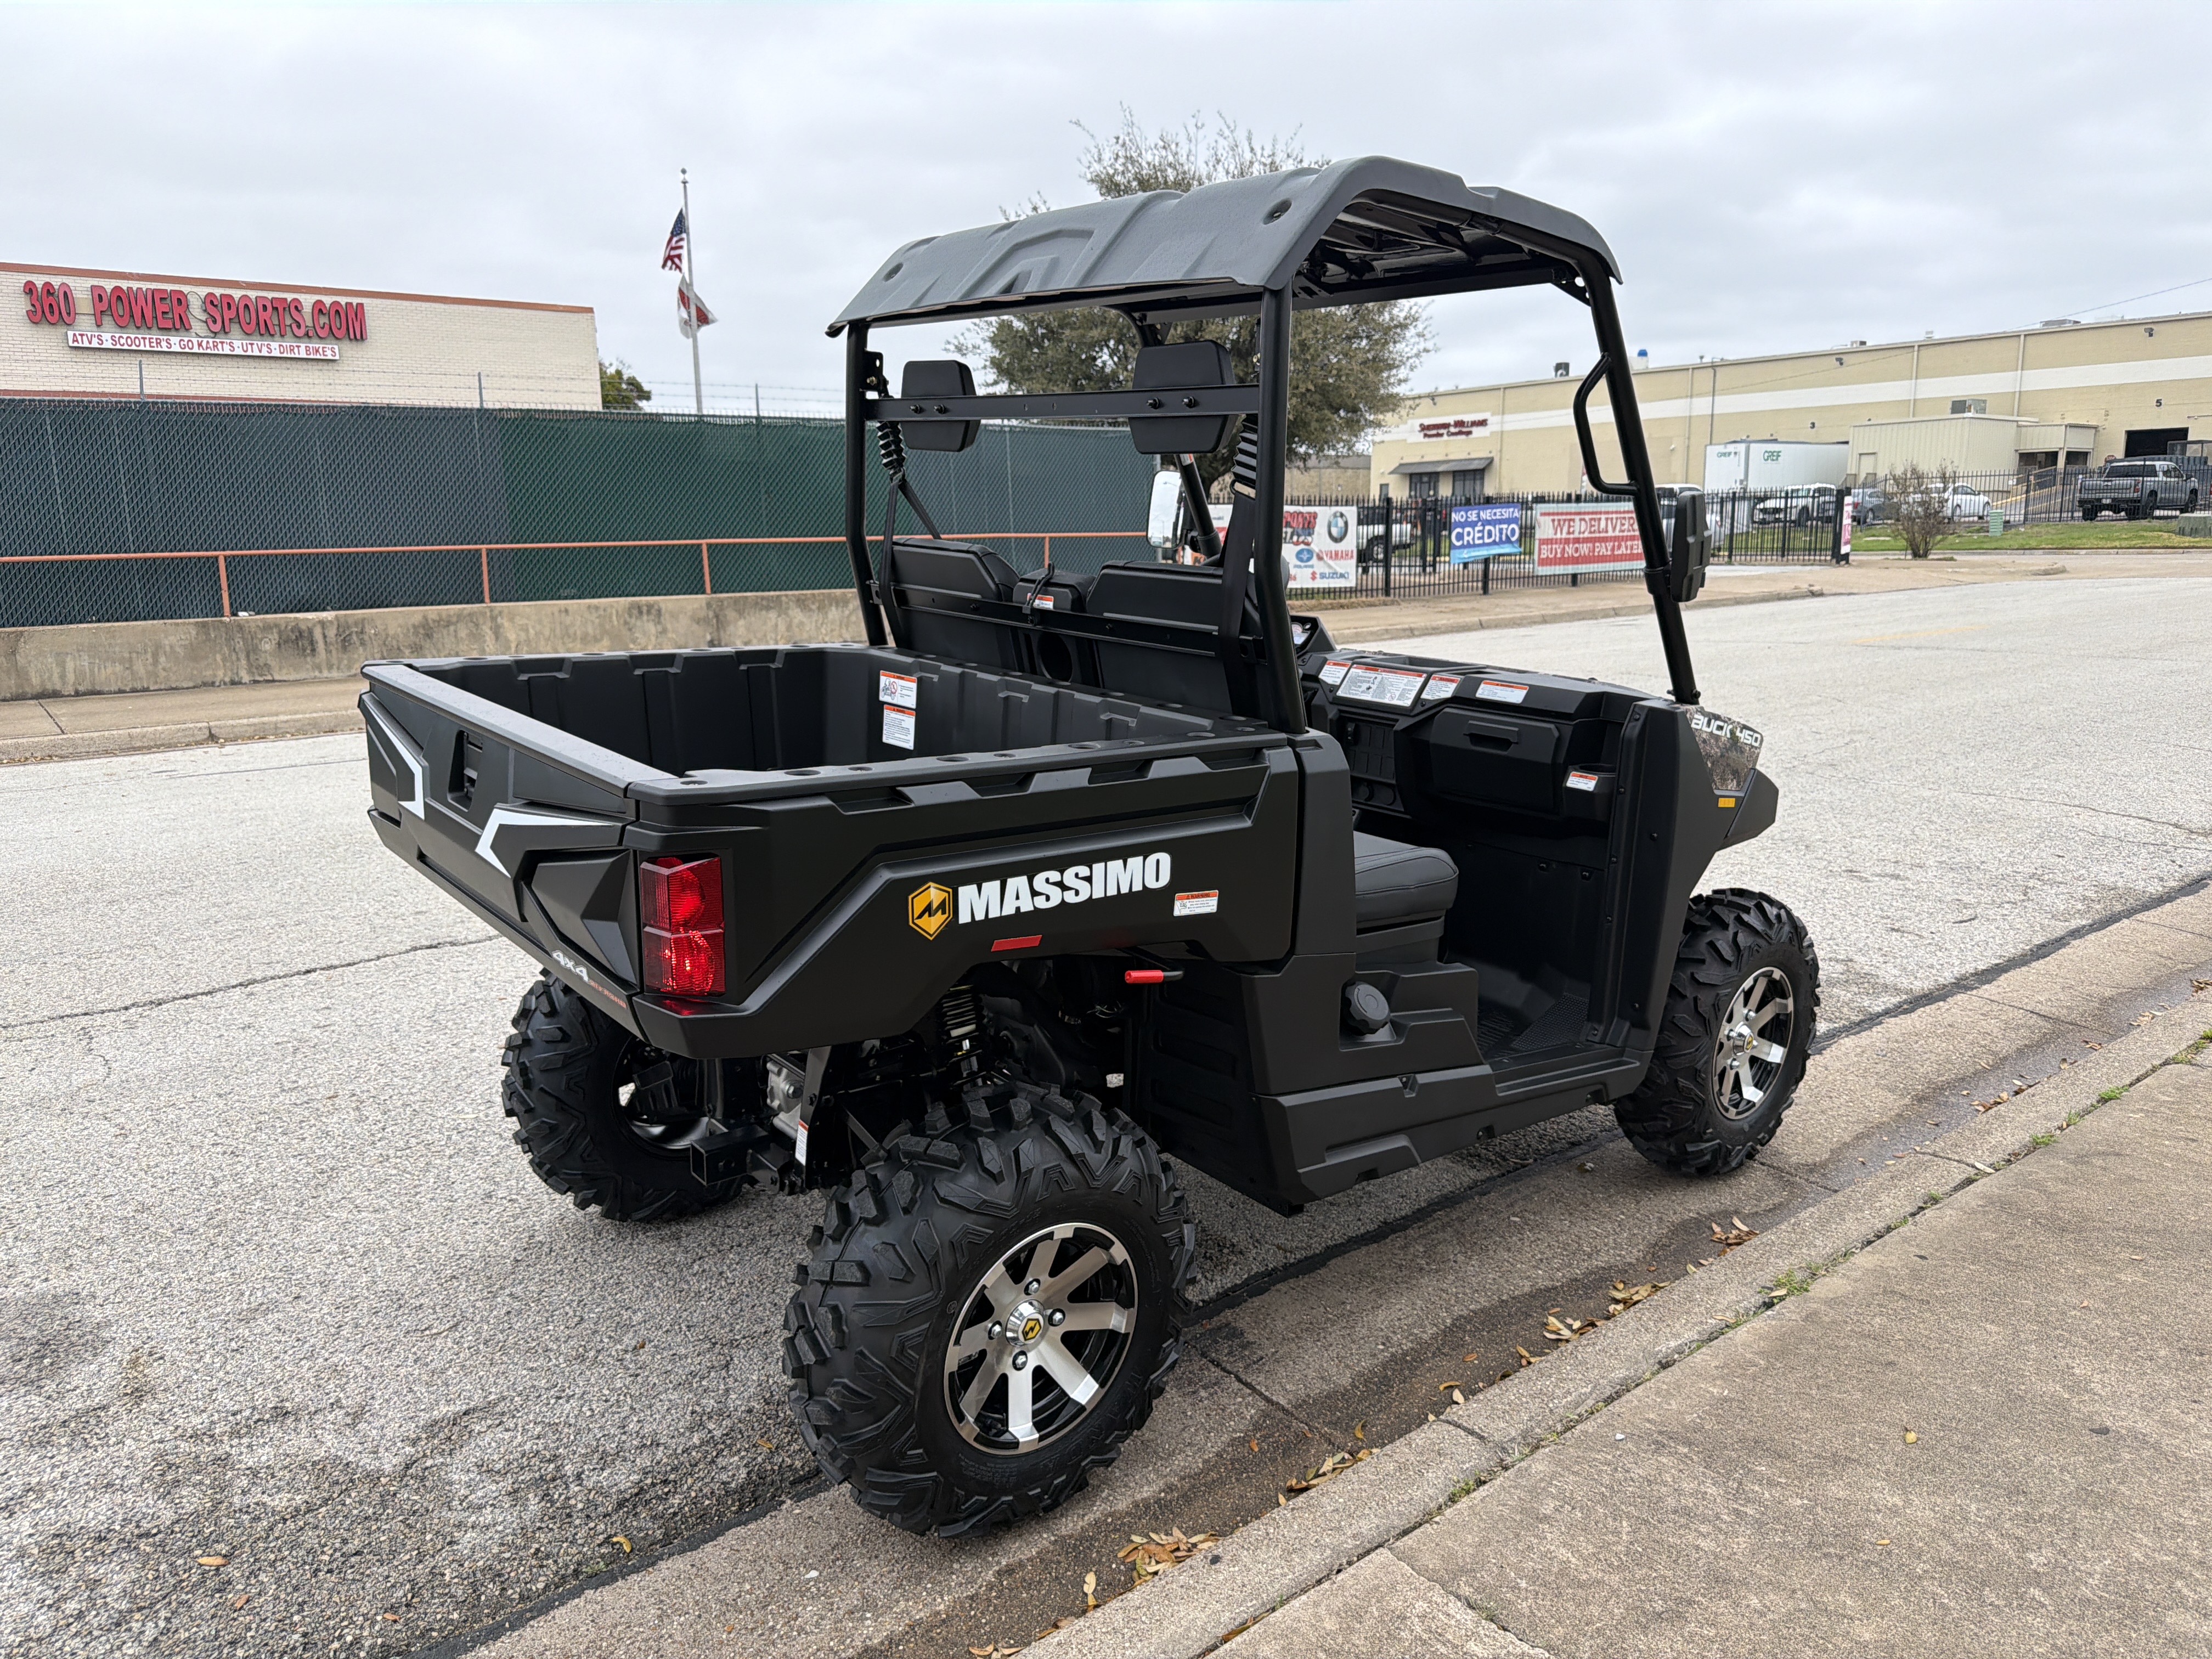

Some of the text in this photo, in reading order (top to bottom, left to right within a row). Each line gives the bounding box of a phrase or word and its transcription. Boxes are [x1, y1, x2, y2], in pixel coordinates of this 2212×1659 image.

[23, 280, 368, 341] 360 POWER SPORTS.COM
[72, 332, 337, 358] ATV'S SCOOTER'S GO KART'S UTV'S DIRT BIKE'S
[2155, 398, 2162, 407] 5
[1763, 450, 1781, 461] GREIF
[1283, 511, 1318, 529] PORTS
[1452, 508, 1519, 522] NO SE NECESITA
[1451, 522, 1520, 546] CRÉDITO
[1551, 516, 1639, 535] WE DELIVER
[1540, 544, 1564, 558] BUY
[1564, 543, 1593, 557] NOW!
[1594, 541, 1614, 556] PAY
[1691, 714, 1762, 747] BUCK 450
[958, 852, 1171, 924] MASSIMO
